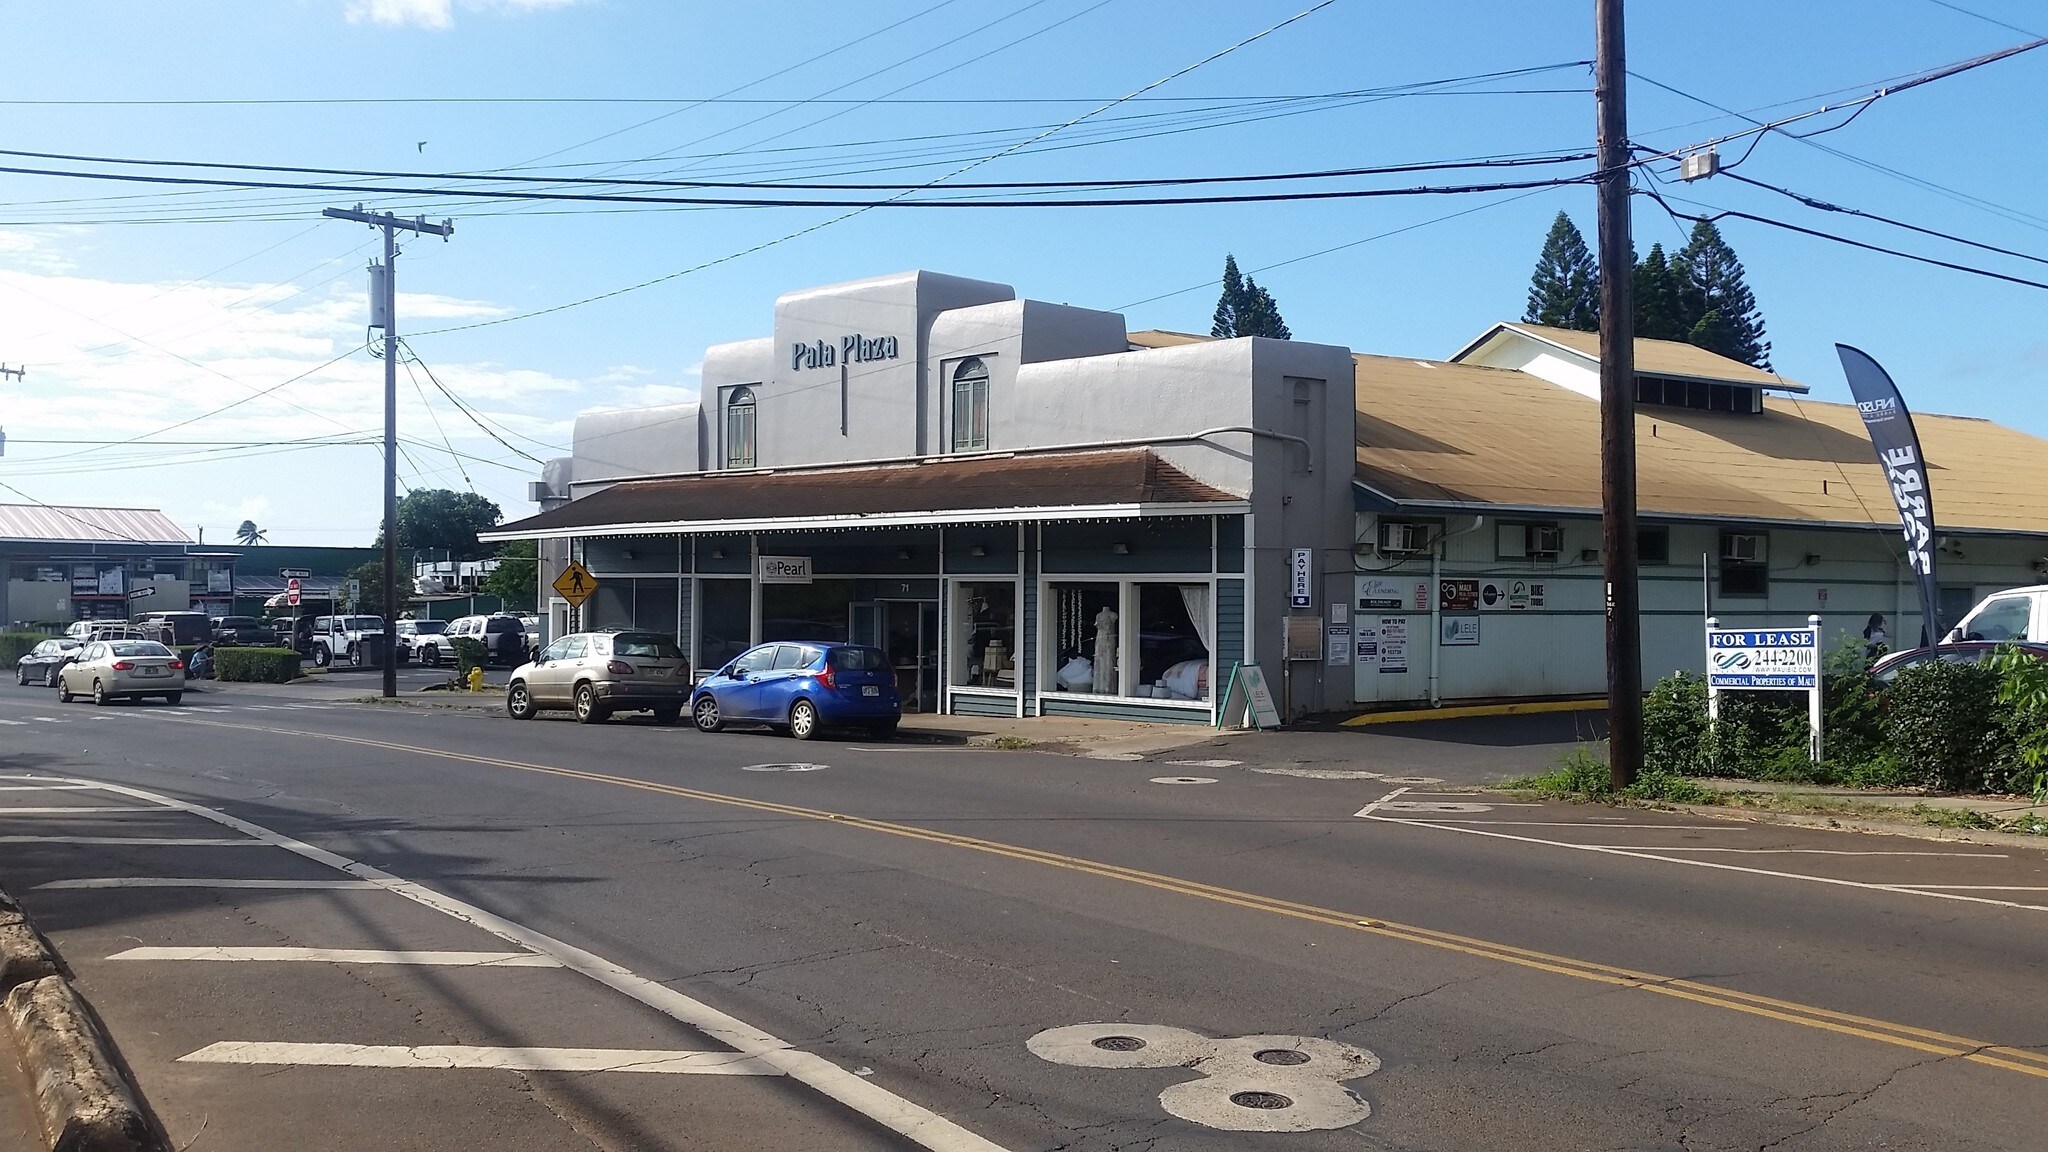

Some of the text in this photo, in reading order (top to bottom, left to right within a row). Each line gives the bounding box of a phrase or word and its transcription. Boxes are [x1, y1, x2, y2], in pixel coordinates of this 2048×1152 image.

[791, 333, 899, 371] Paia Plaza
[777, 560, 806, 575] Pearl
[1297, 552, 1306, 595] PAY HERE
[901, 583, 909, 592] 71
[1530, 584, 1544, 596] BIKE
[1530, 598, 1544, 607] TOURS
[1460, 623, 1477, 634] LELE
[1711, 632, 1812, 646] FOR LEASE
[1754, 649, 1812, 666] 244-2200
